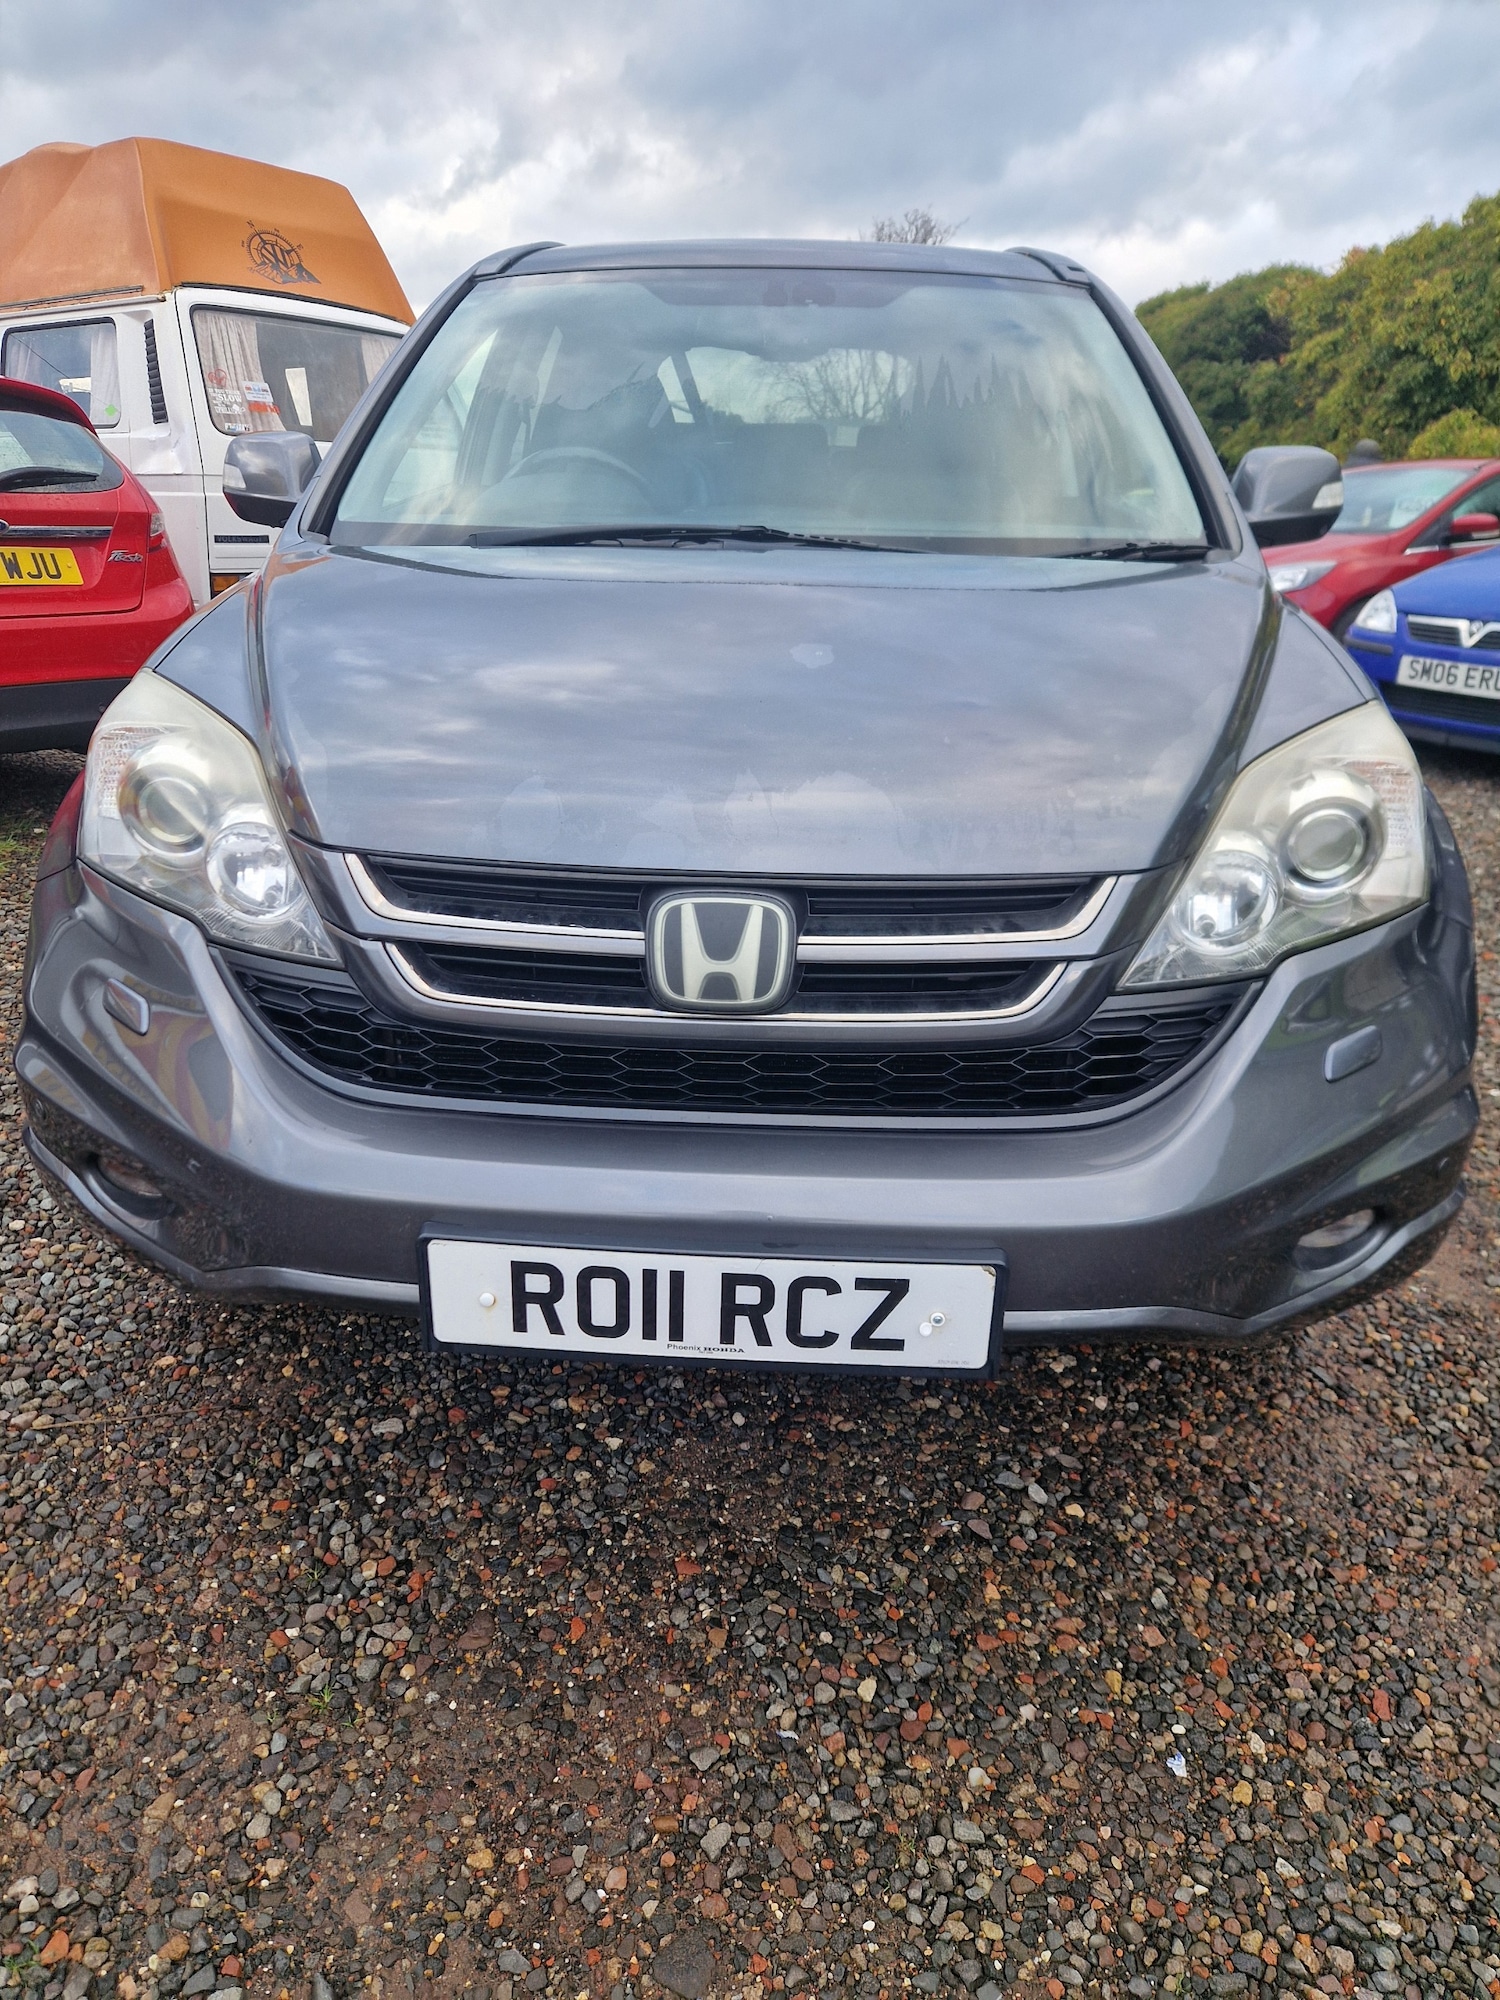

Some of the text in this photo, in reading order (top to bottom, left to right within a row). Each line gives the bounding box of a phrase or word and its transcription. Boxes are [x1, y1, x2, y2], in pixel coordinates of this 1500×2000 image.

[217, 393, 242, 403] SLOW
[0, 551, 62, 580] WJU
[1408, 659, 1459, 685] SM06
[510, 1260, 911, 1352] RO11 RCZ
[666, 1343, 701, 1352] Phoenix
